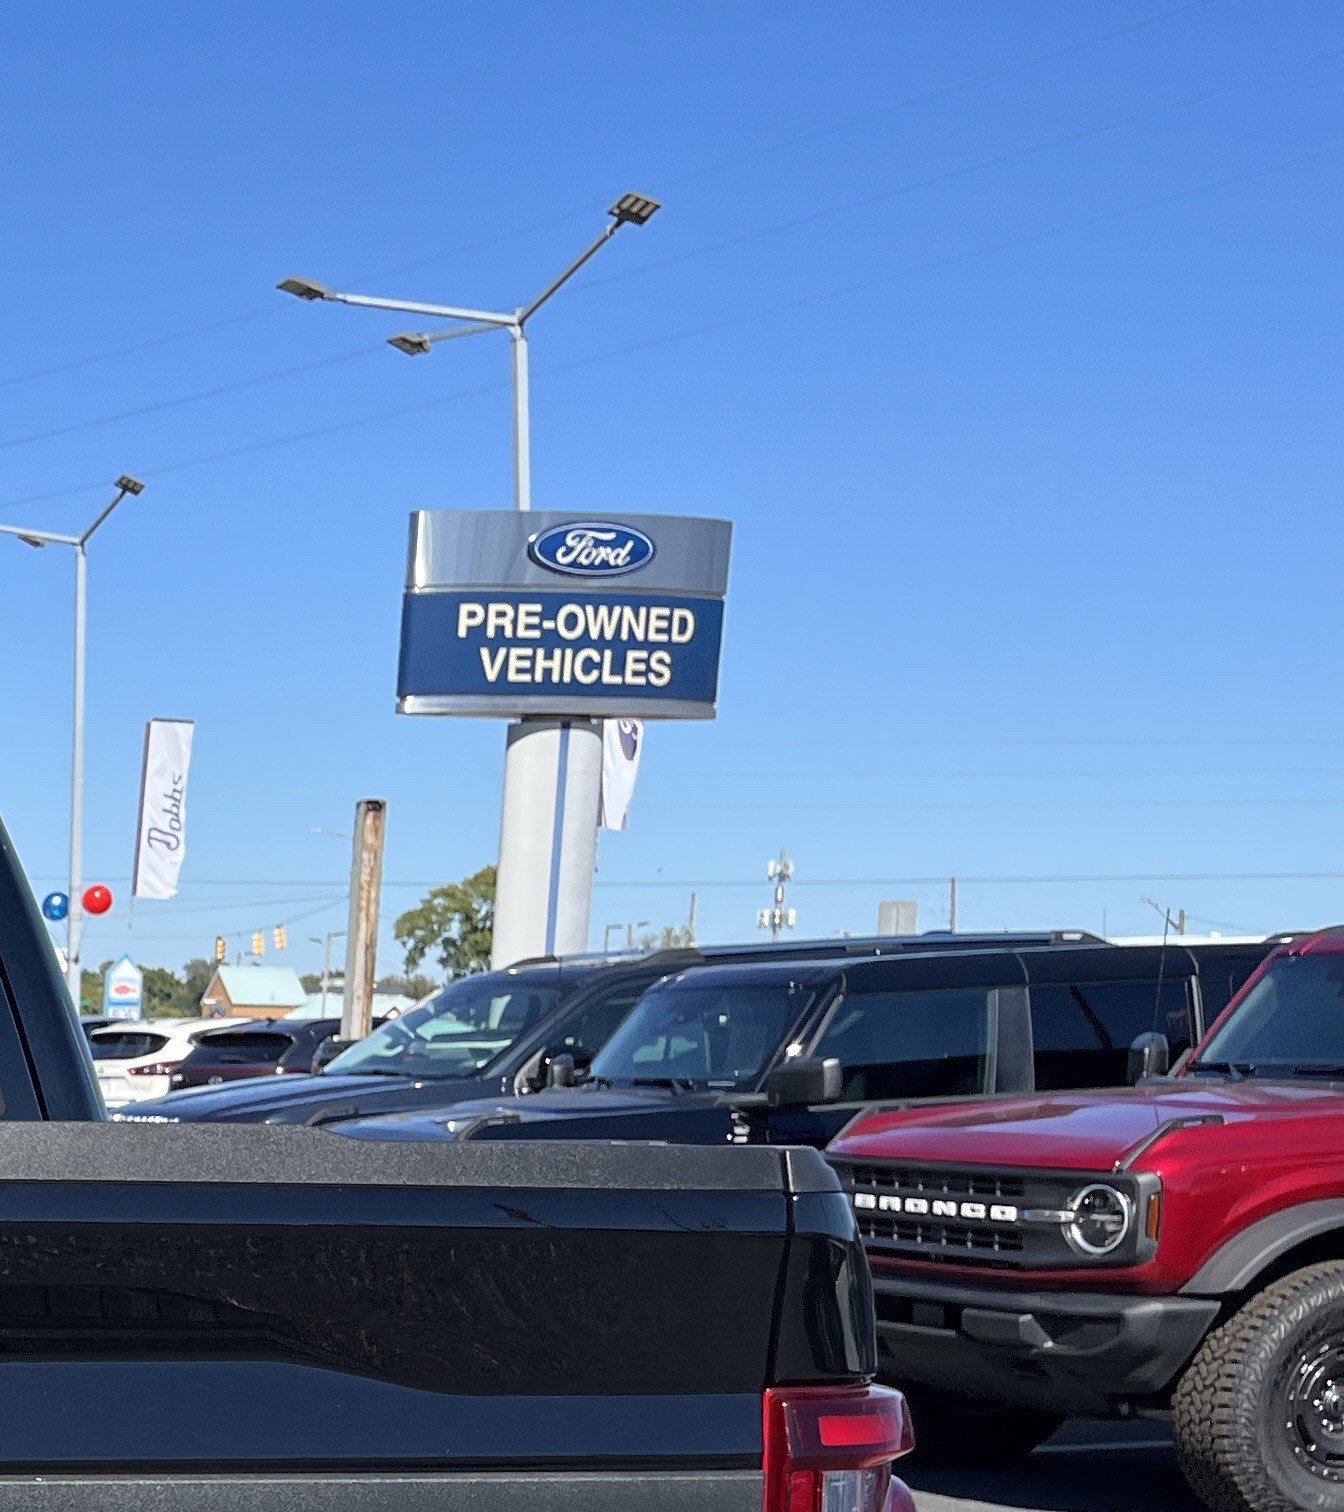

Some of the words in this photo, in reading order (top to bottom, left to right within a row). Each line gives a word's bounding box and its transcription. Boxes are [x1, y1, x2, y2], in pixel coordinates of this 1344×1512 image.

[555, 528, 635, 568] Ford
[457, 602, 695, 643] PRE-OWNED
[479, 646, 673, 687] VEHICLES
[147, 770, 183, 852] Dobbs
[854, 1192, 1018, 1222] BRONCO
